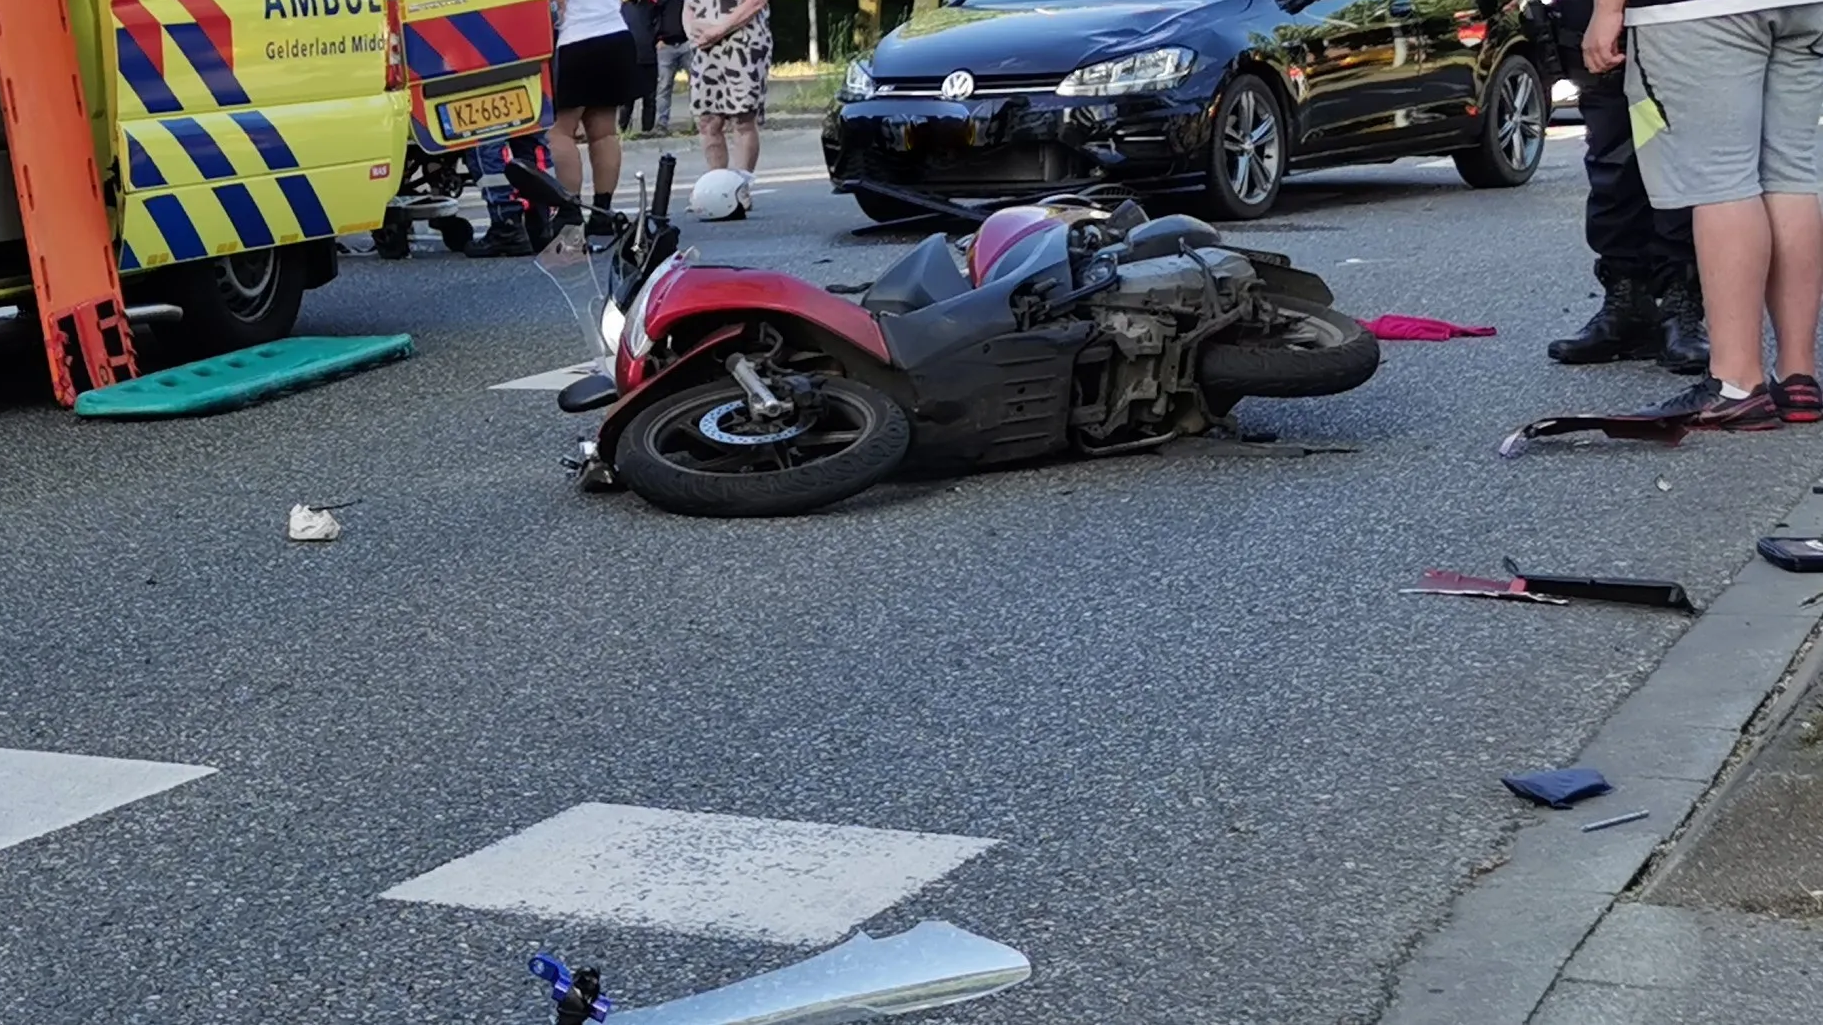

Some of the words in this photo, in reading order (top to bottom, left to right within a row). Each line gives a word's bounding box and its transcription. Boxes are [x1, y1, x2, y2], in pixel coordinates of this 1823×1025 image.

[265, 36, 346, 60] Gelderland
[351, 33, 386, 53] Midd
[454, 93, 523, 128] KZ-663-J
